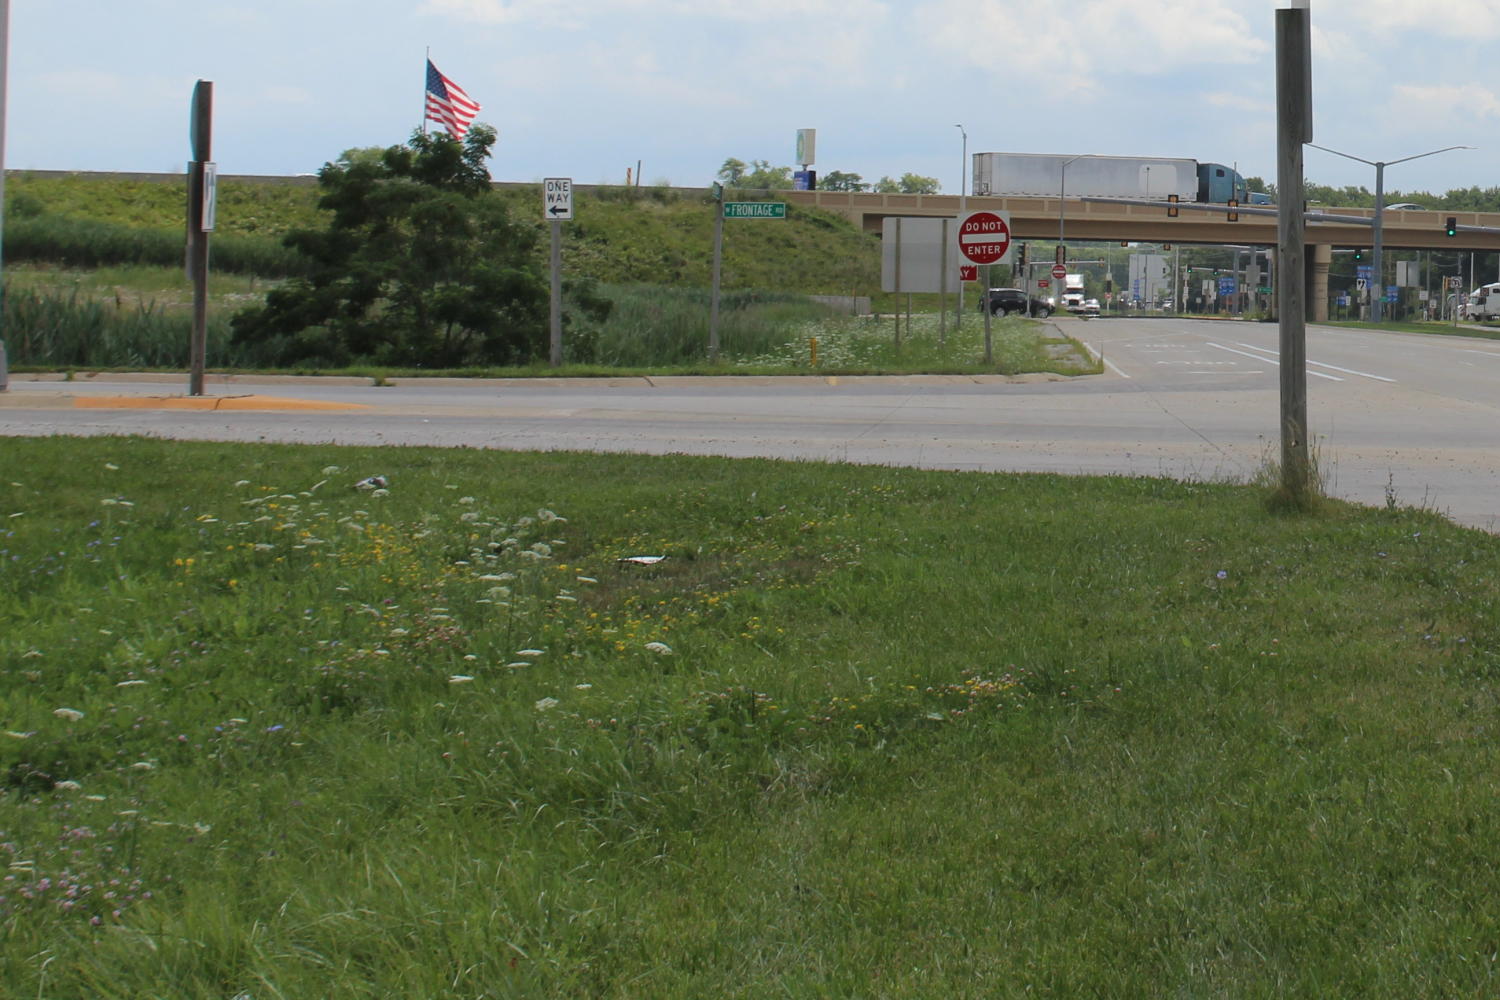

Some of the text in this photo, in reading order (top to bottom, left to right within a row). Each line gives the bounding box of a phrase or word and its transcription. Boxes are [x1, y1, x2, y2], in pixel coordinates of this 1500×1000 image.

[548, 181, 569, 192] ONE
[547, 193, 569, 203] WAY
[732, 204, 774, 216] FRONTAGE
[966, 221, 1002, 231] DO NOT
[968, 245, 1001, 255] ENTER
